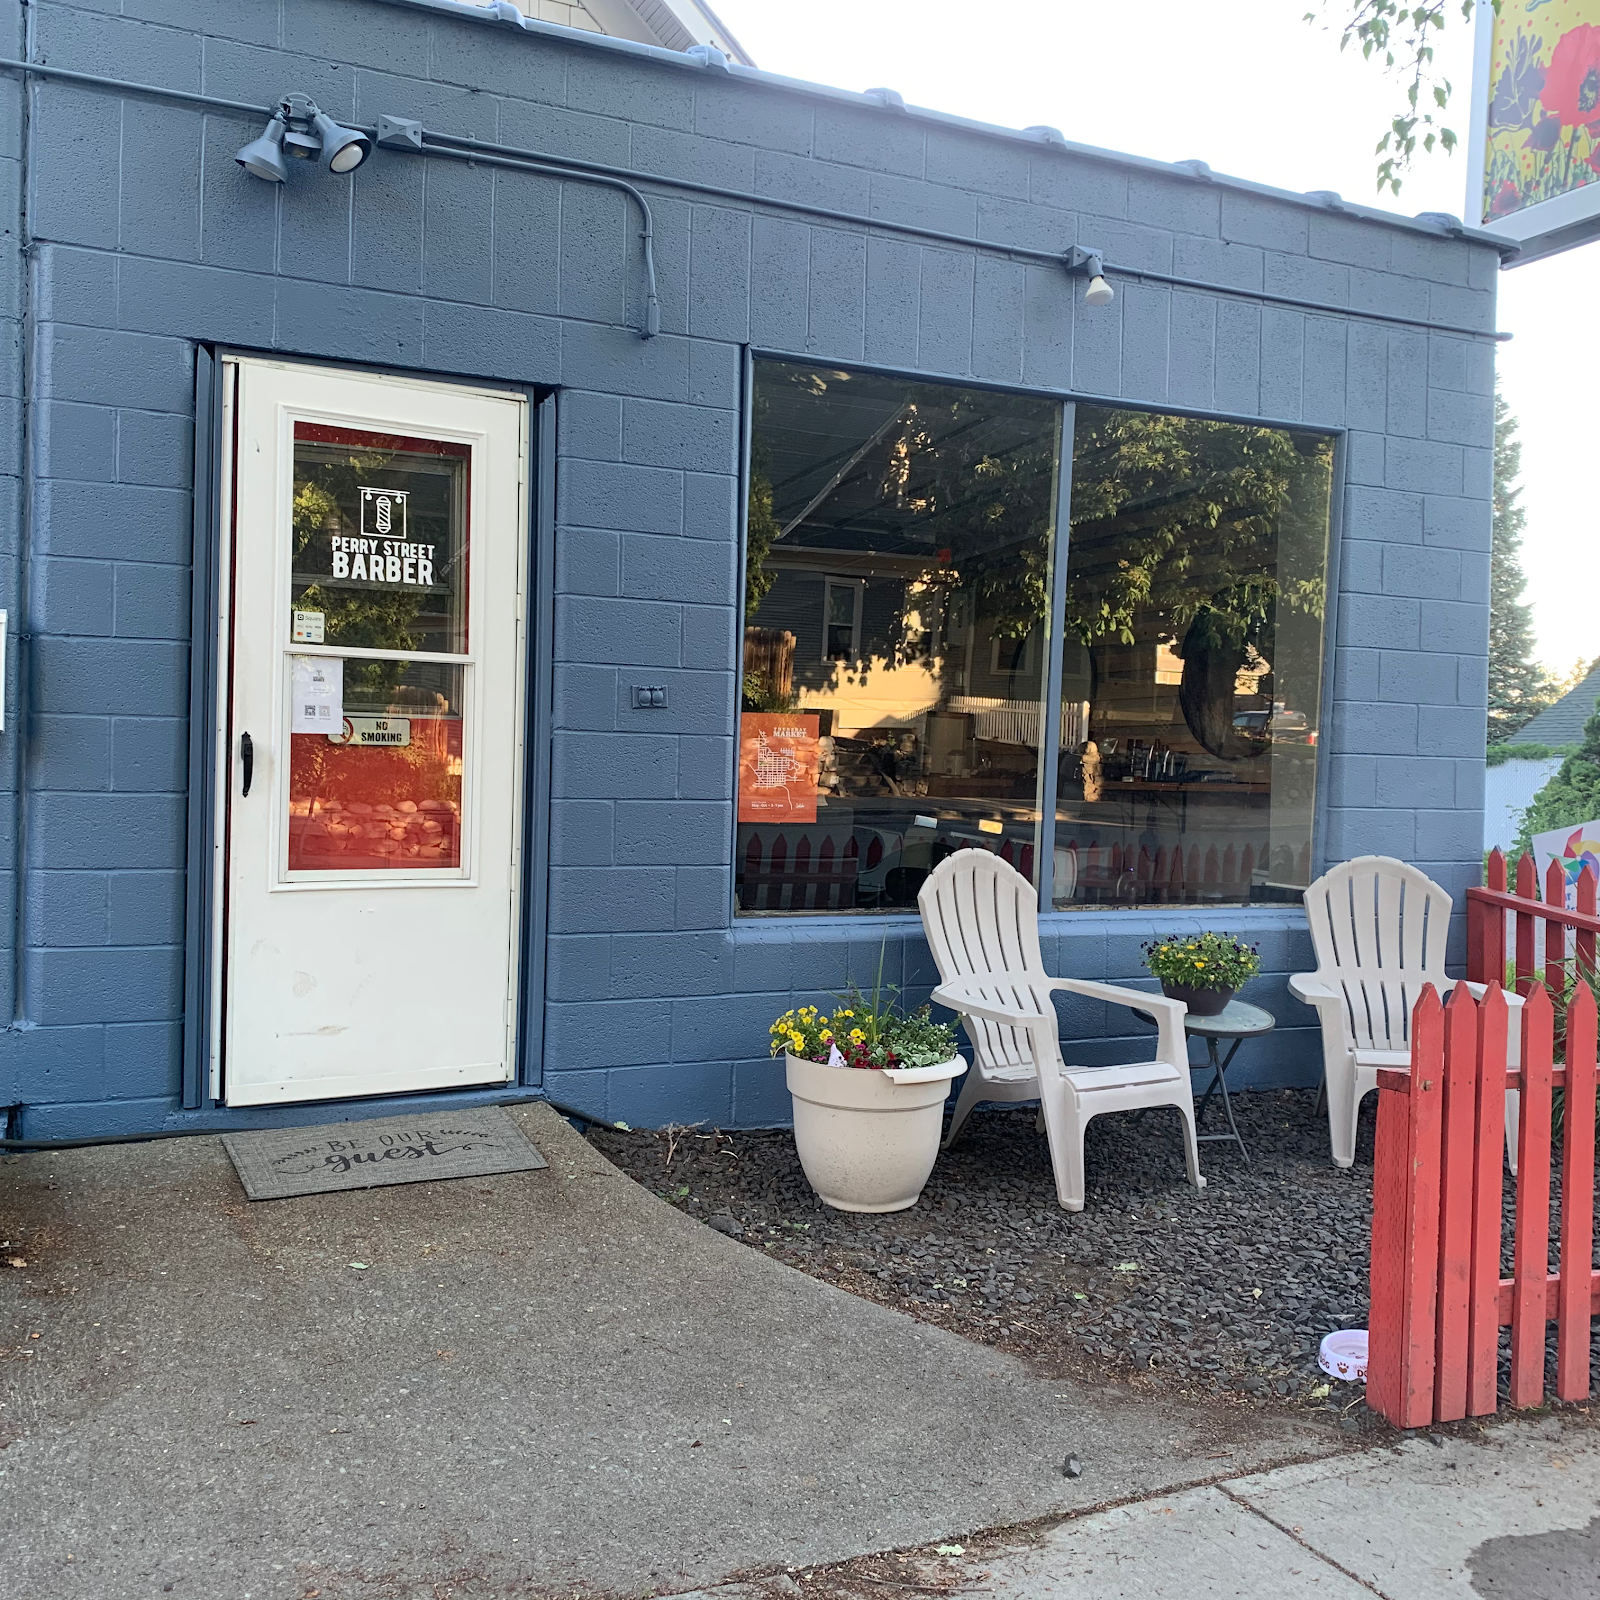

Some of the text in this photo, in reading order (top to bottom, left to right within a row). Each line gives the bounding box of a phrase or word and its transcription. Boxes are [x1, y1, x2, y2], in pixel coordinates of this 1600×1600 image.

[331, 536, 435, 560] PERRY STREET
[331, 551, 434, 586] BARBER
[361, 732, 402, 743] SMOKING
[376, 721, 388, 731] NO
[327, 1130, 440, 1153] BE OUR
[323, 1141, 445, 1174] guest
